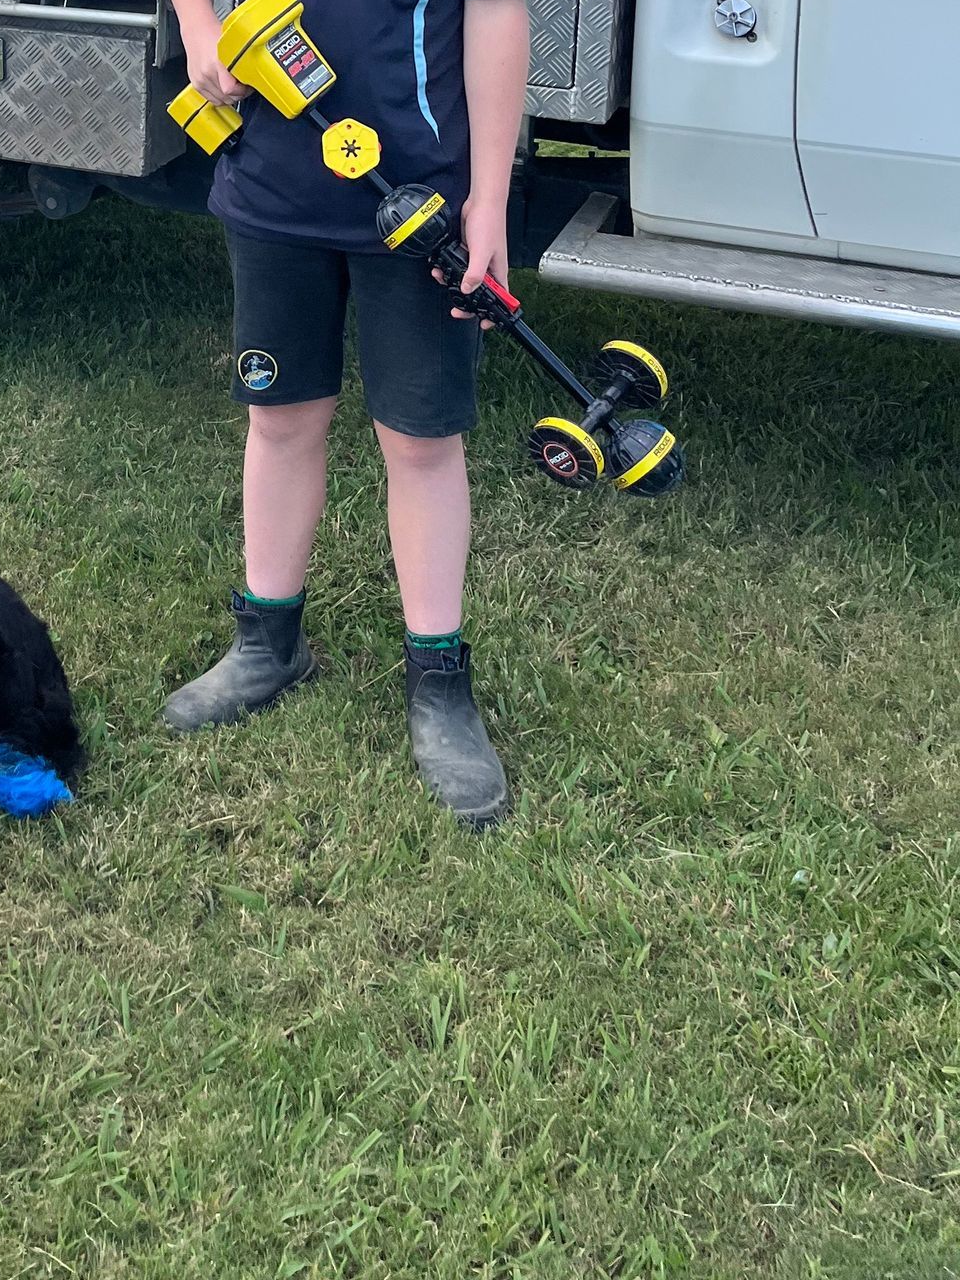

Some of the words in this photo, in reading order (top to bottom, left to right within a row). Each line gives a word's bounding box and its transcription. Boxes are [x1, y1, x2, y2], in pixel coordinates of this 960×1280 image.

[274, 34, 301, 59] RIDGID
[421, 196, 440, 215] RIDGID
[653, 435, 671, 457] RIDGID
